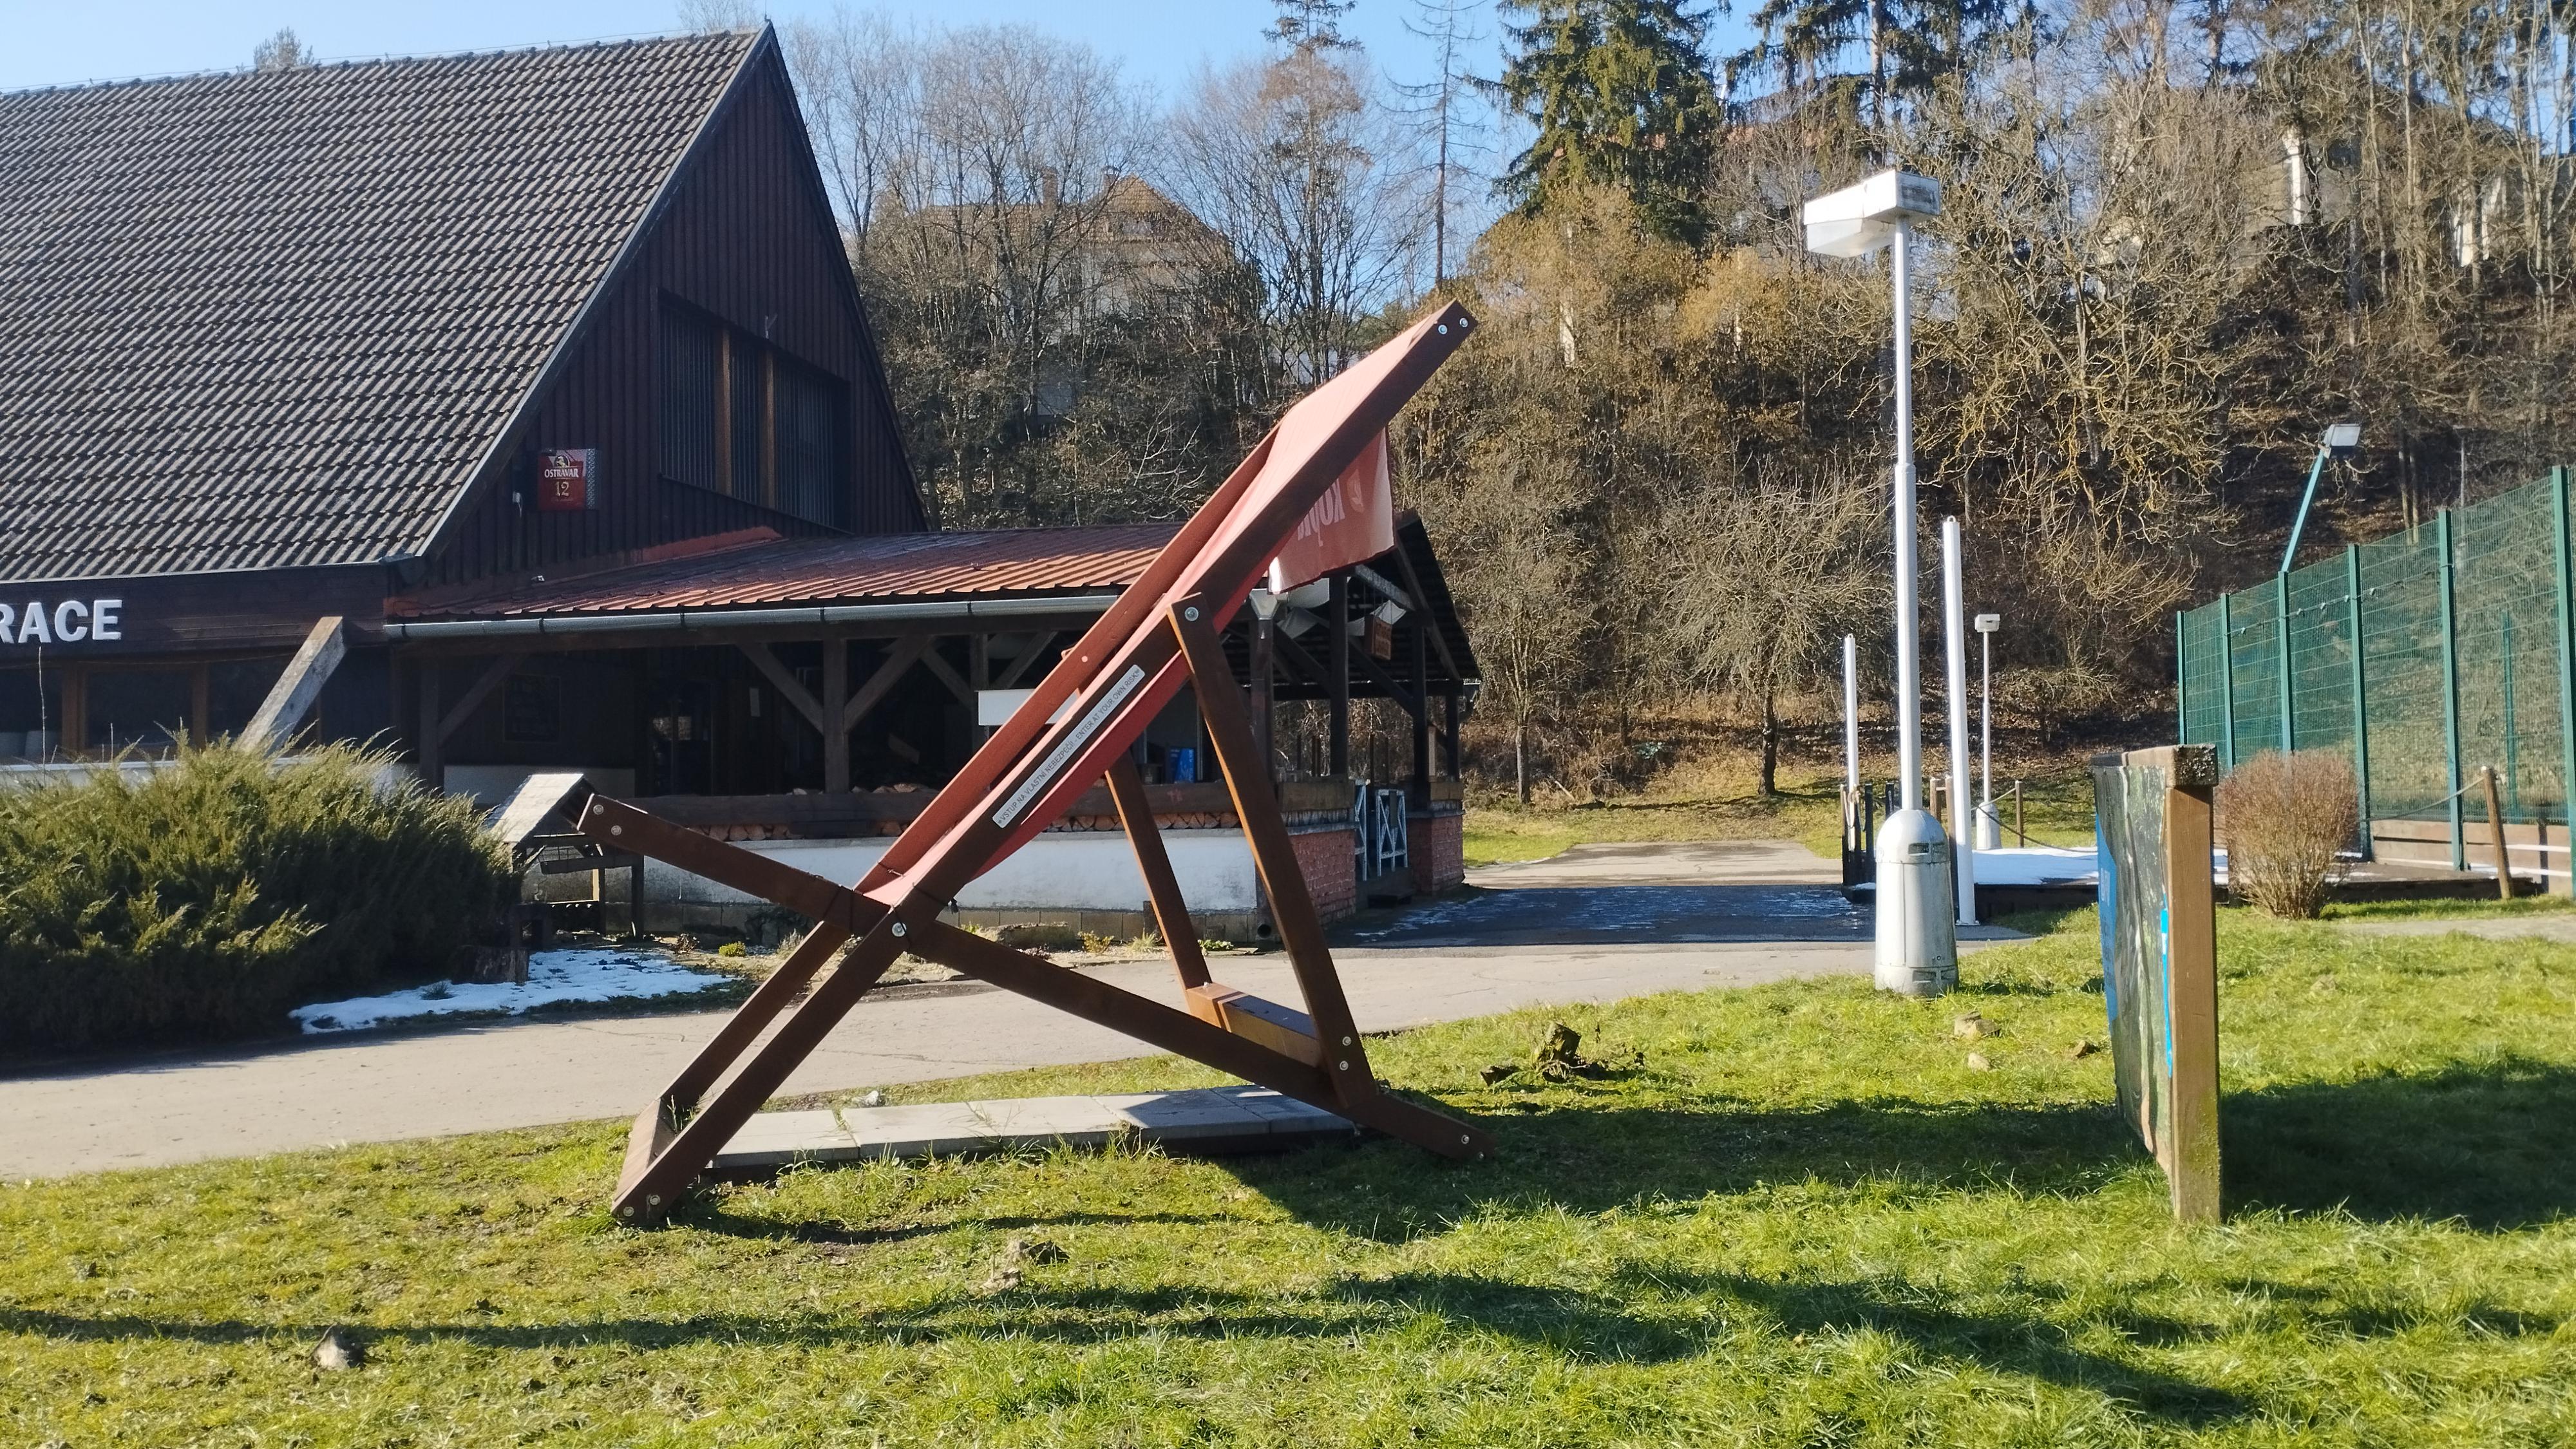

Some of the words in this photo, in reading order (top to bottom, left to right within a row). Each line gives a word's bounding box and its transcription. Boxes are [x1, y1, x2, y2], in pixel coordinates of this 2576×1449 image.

[544, 468, 579, 478] OSTRAVAR
[554, 481, 569, 497] 12
[999, 799, 1021, 821] VSTUP
[1016, 792, 1027, 803] NA
[1023, 769, 1048, 795] VLASTNÍ
[1075, 719, 1095, 740] ENTER
[1092, 712, 1102, 723] AT
[1112, 684, 1127, 700] OWN
